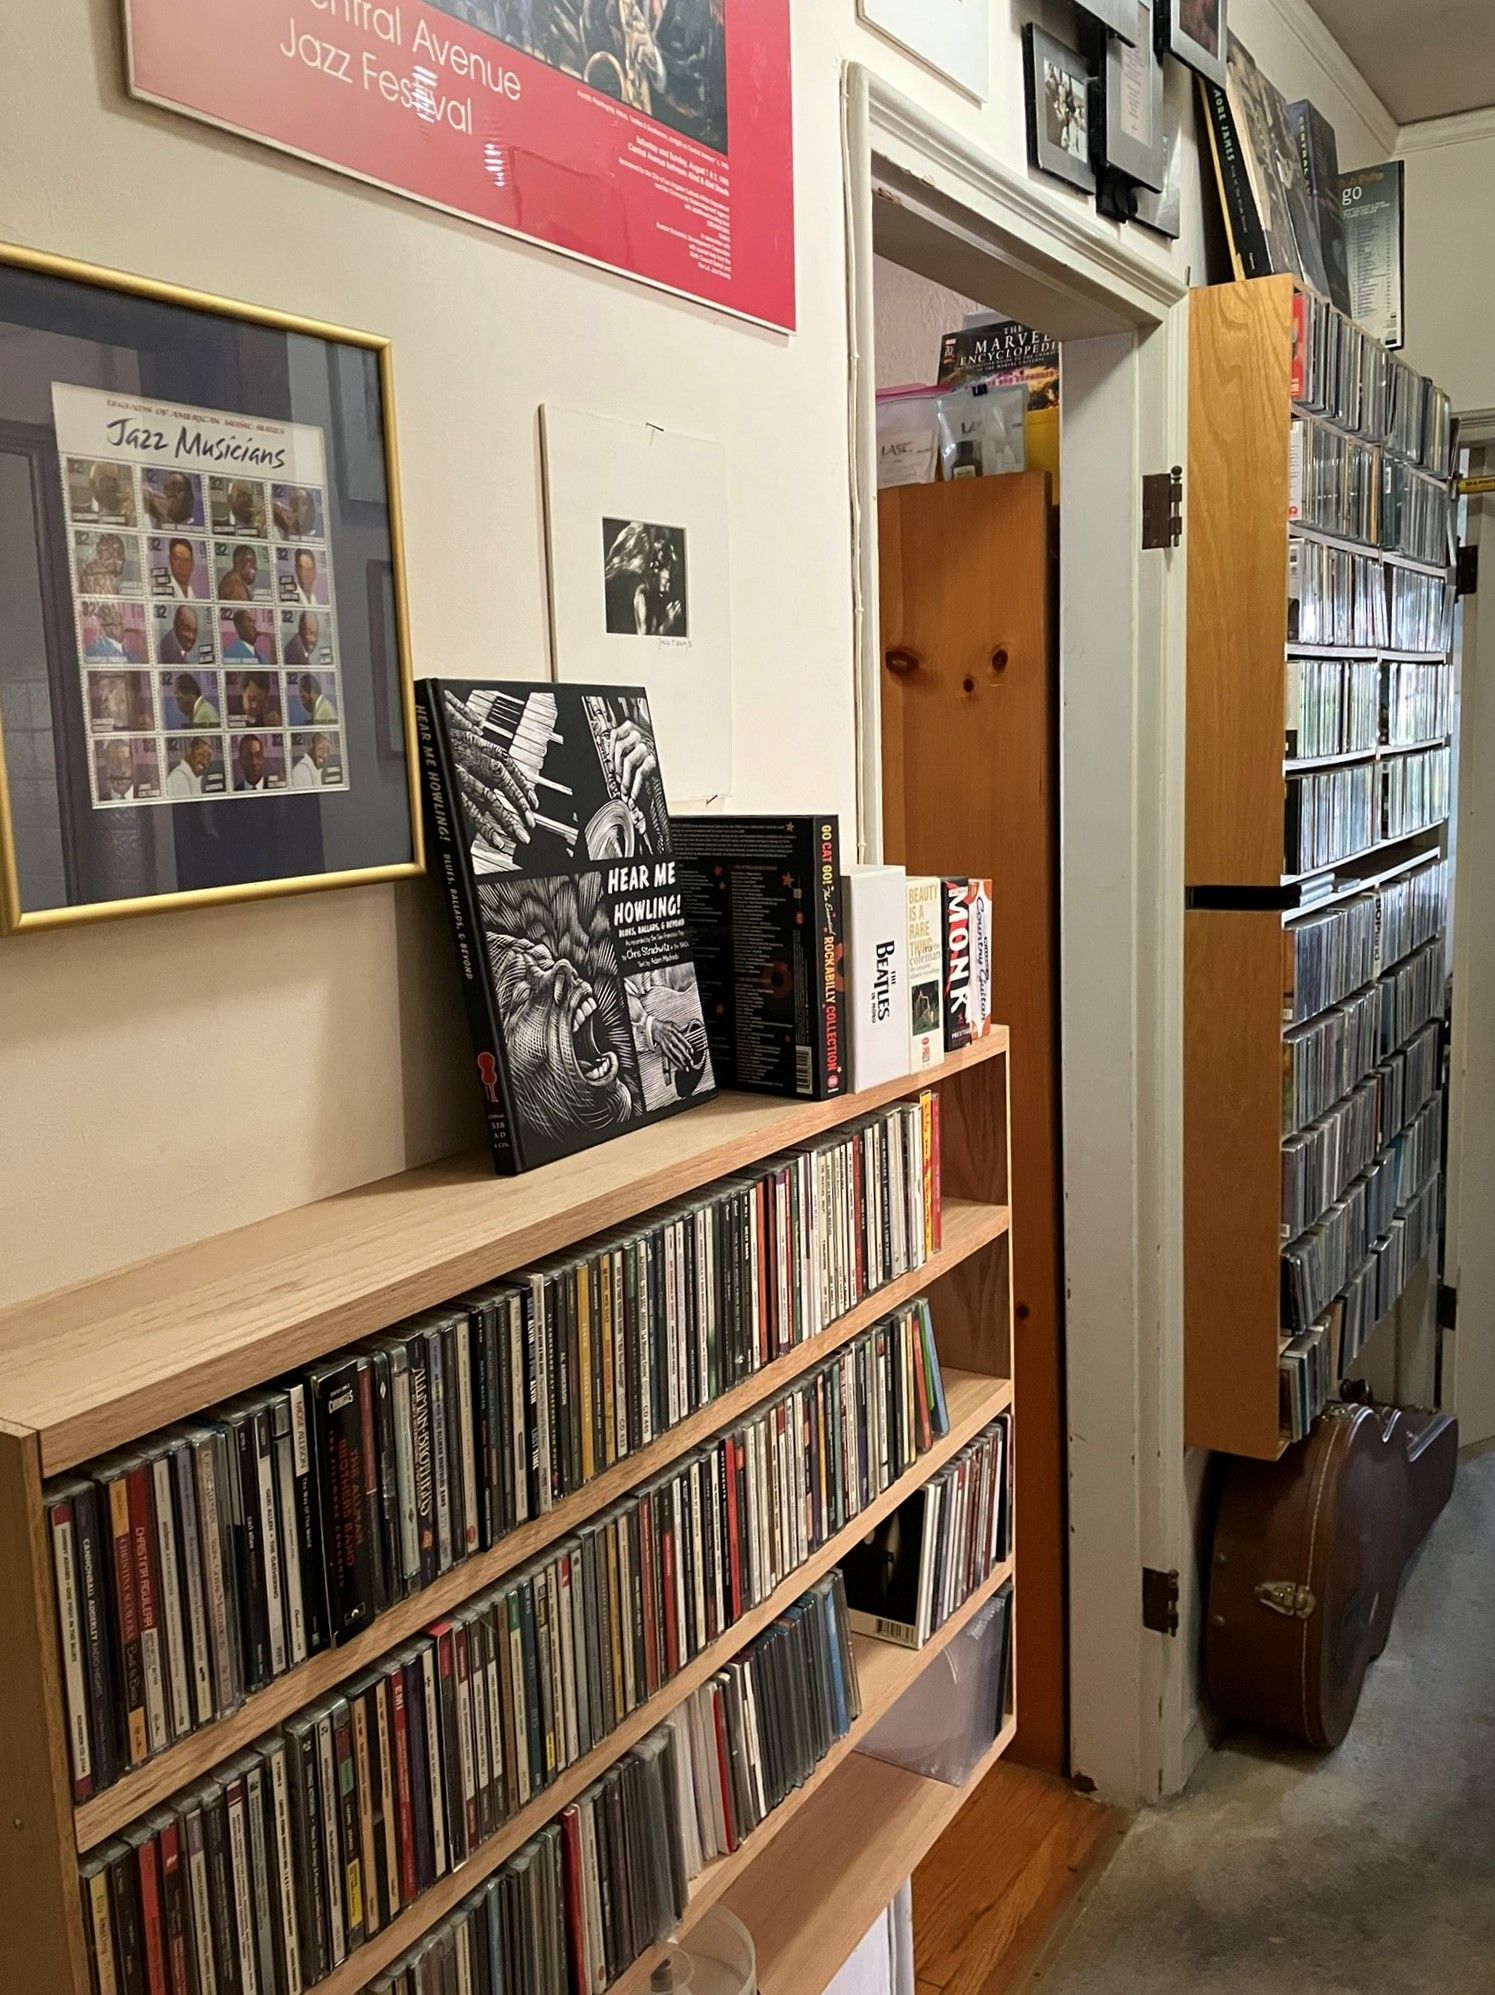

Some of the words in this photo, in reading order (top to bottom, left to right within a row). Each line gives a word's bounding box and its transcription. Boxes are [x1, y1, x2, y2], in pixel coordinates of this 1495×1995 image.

[280, 18, 353, 84] Jazz
[412, 18, 521, 101] Avenue
[1213, 89, 1227, 121] MORE
[1221, 125, 1236, 161] JAMES
[627, 142, 647, 159] Central
[974, 329, 1052, 355] MARVEL
[1002, 324, 1024, 335] THE
[959, 341, 1057, 366] ENCYCLOPEDI
[106, 417, 168, 451] Jazz
[174, 426, 286, 469] Musicians
[415, 704, 432, 741] HEAR
[422, 745, 437, 768] ME
[427, 771, 450, 842] HOWLING!
[822, 824, 832, 841] GO
[822, 842, 832, 863] CAT
[607, 864, 650, 894] HEAR
[653, 861, 677, 888] ME
[822, 864, 833, 885] GO!
[613, 894, 681, 927] HOWLING!
[908, 884, 938, 904] BEAUTY
[443, 853, 455, 885] BLUES,
[449, 888, 464, 930] BALLADS,
[460, 942, 474, 980] BEYOND
[909, 906, 917, 922] IS
[918, 904, 924, 920] A
[909, 921, 930, 938] RARE
[976, 896, 985, 966] Country
[948, 886, 970, 1014] MONK
[823, 935, 836, 1003] ROCKABILLY
[873, 940, 896, 1022] BEATLES
[979, 968, 989, 1021] Guitar
[826, 1005, 838, 1072] COLLECTION
[527, 1319, 536, 1345] ALVIN
[560, 1351, 566, 1363] AL
[412, 1367, 429, 1430] ALLMAN
[529, 1379, 537, 1405] ALVIN
[296, 1401, 304, 1430] MOSE
[619, 1418, 626, 1433] CD
[643, 1404, 649, 1419] CD
[298, 1430, 307, 1469] ALLISON
[530, 1426, 539, 1450] LOST
[418, 1431, 432, 1517] BROTHERS
[531, 1448, 539, 1471] TIME
[338, 1438, 353, 1520] BROTHERS
[353, 1483, 364, 1546] ALLMAN
[136, 1526, 149, 1579] CHRISTINA
[269, 1539, 277, 1554] THE
[345, 1522, 356, 1567] BAND
[83, 1538, 95, 1598] CANNONBALL
[270, 1555, 279, 1600] GATHERING
[88, 1599, 99, 1641] ADDERLEY
[141, 1579, 153, 1629] AGUILERA
[394, 1684, 404, 1711] EMI
